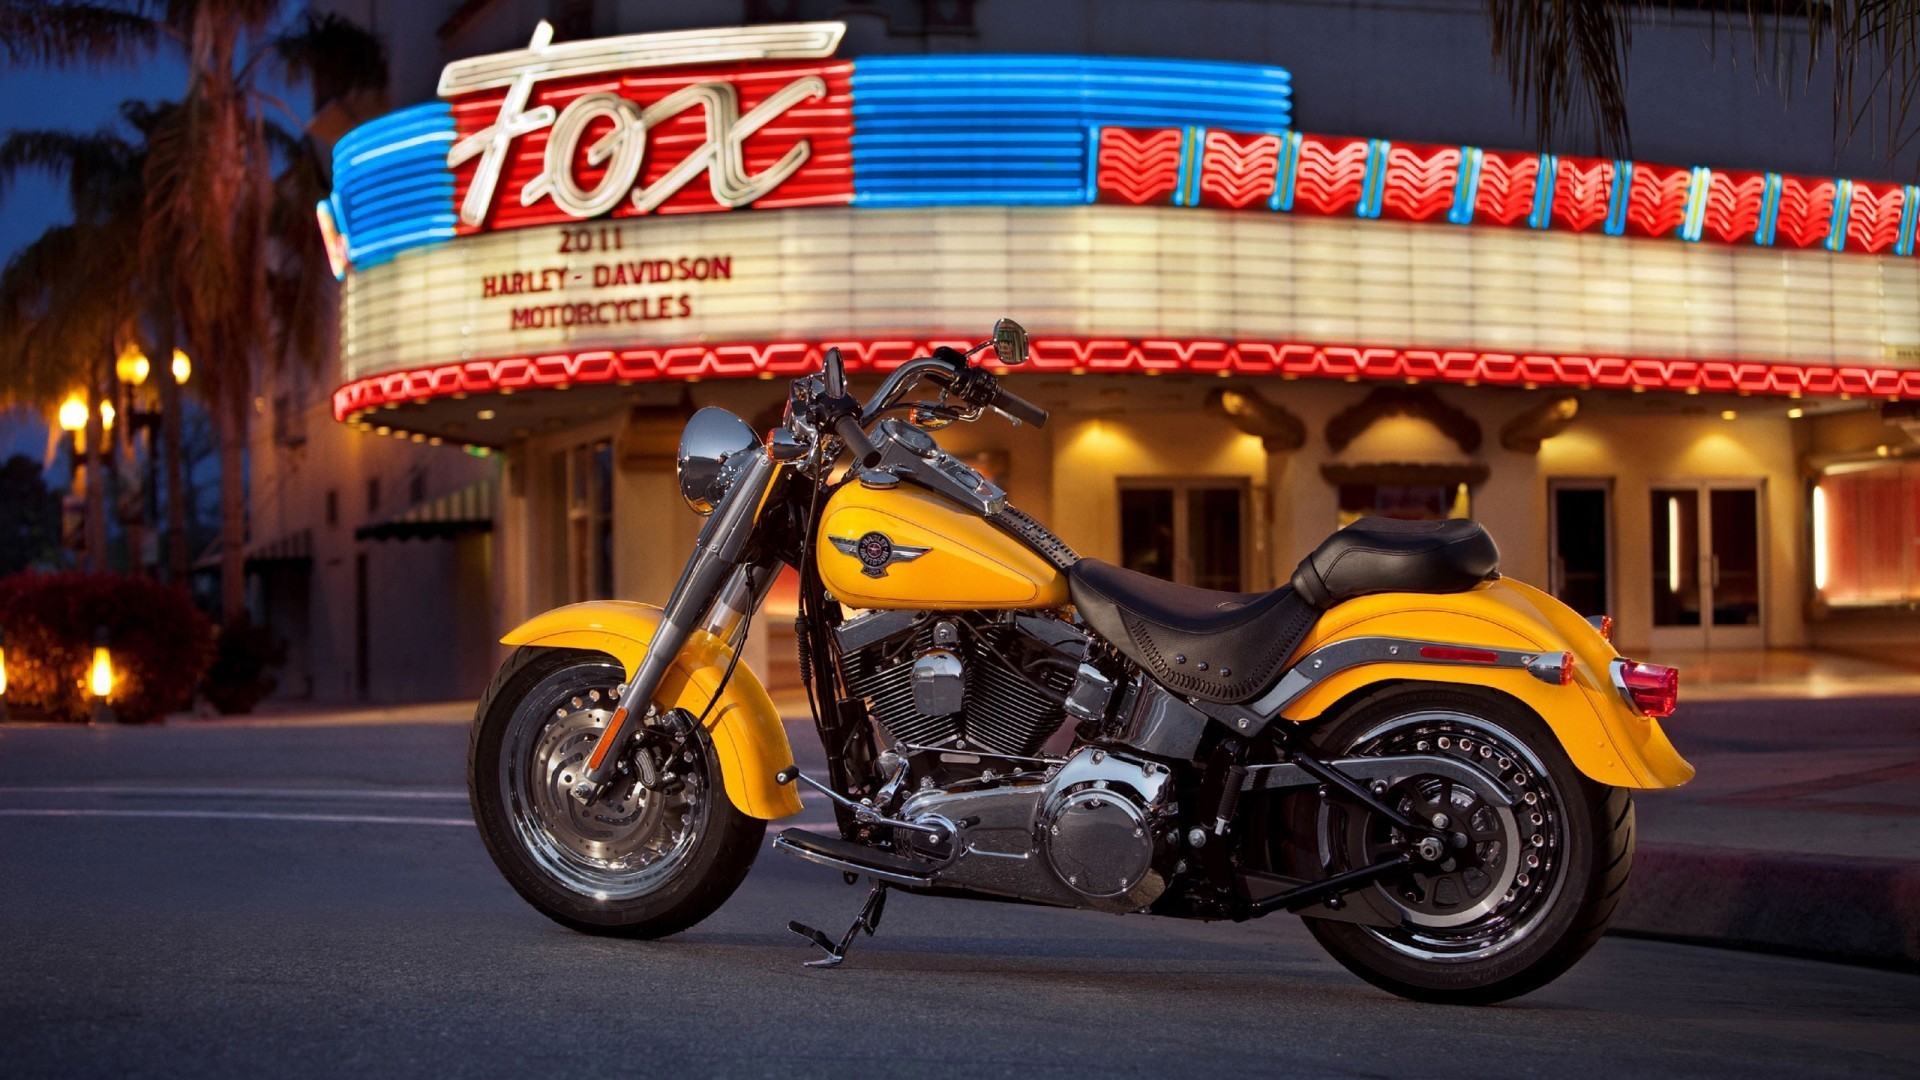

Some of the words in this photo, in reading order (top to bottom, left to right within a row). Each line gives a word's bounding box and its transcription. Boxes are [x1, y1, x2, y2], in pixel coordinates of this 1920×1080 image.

[557, 227, 623, 254] 2011
[482, 267, 569, 298] HARLEY
[592, 255, 733, 289] DAVIDSON
[510, 294, 692, 331] MOTORCYCLES
